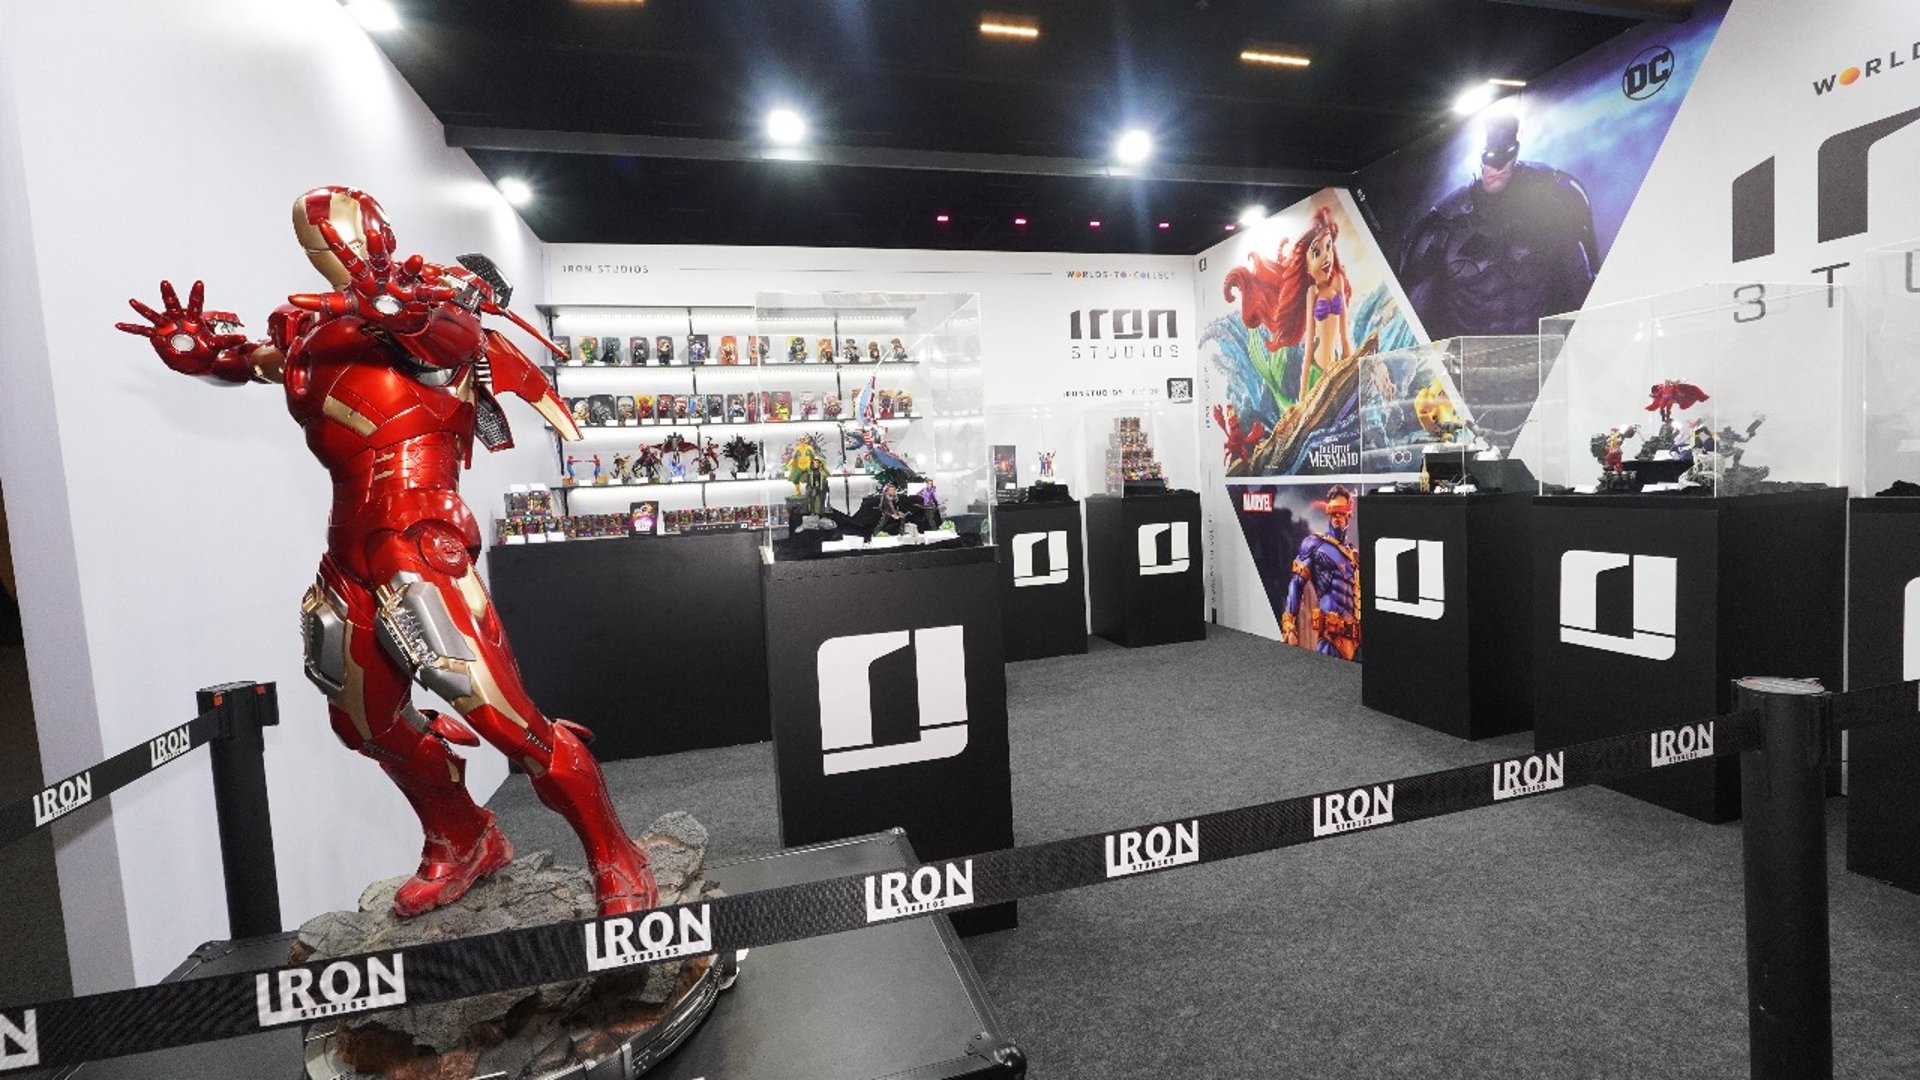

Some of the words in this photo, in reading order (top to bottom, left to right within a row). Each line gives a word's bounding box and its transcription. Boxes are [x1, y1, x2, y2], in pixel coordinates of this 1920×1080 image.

[1626, 47, 1671, 96] DC
[561, 264, 593, 274] IRON
[597, 264, 649, 274] STUDIOS
[1309, 450, 1359, 470] MERMAID
[1243, 493, 1273, 512] MARVEL
[150, 724, 191, 768] IRON
[1651, 721, 1714, 768] IRON
[33, 771, 92, 828] IRON
[1493, 751, 1564, 800] IRON
[1313, 784, 1394, 837] IRON
[1105, 820, 1199, 878] IRON
[865, 859, 974, 923] IRON
[584, 904, 713, 972] IRON
[256, 953, 407, 1027] IRON
[300, 999, 369, 1018] STUDIOS
